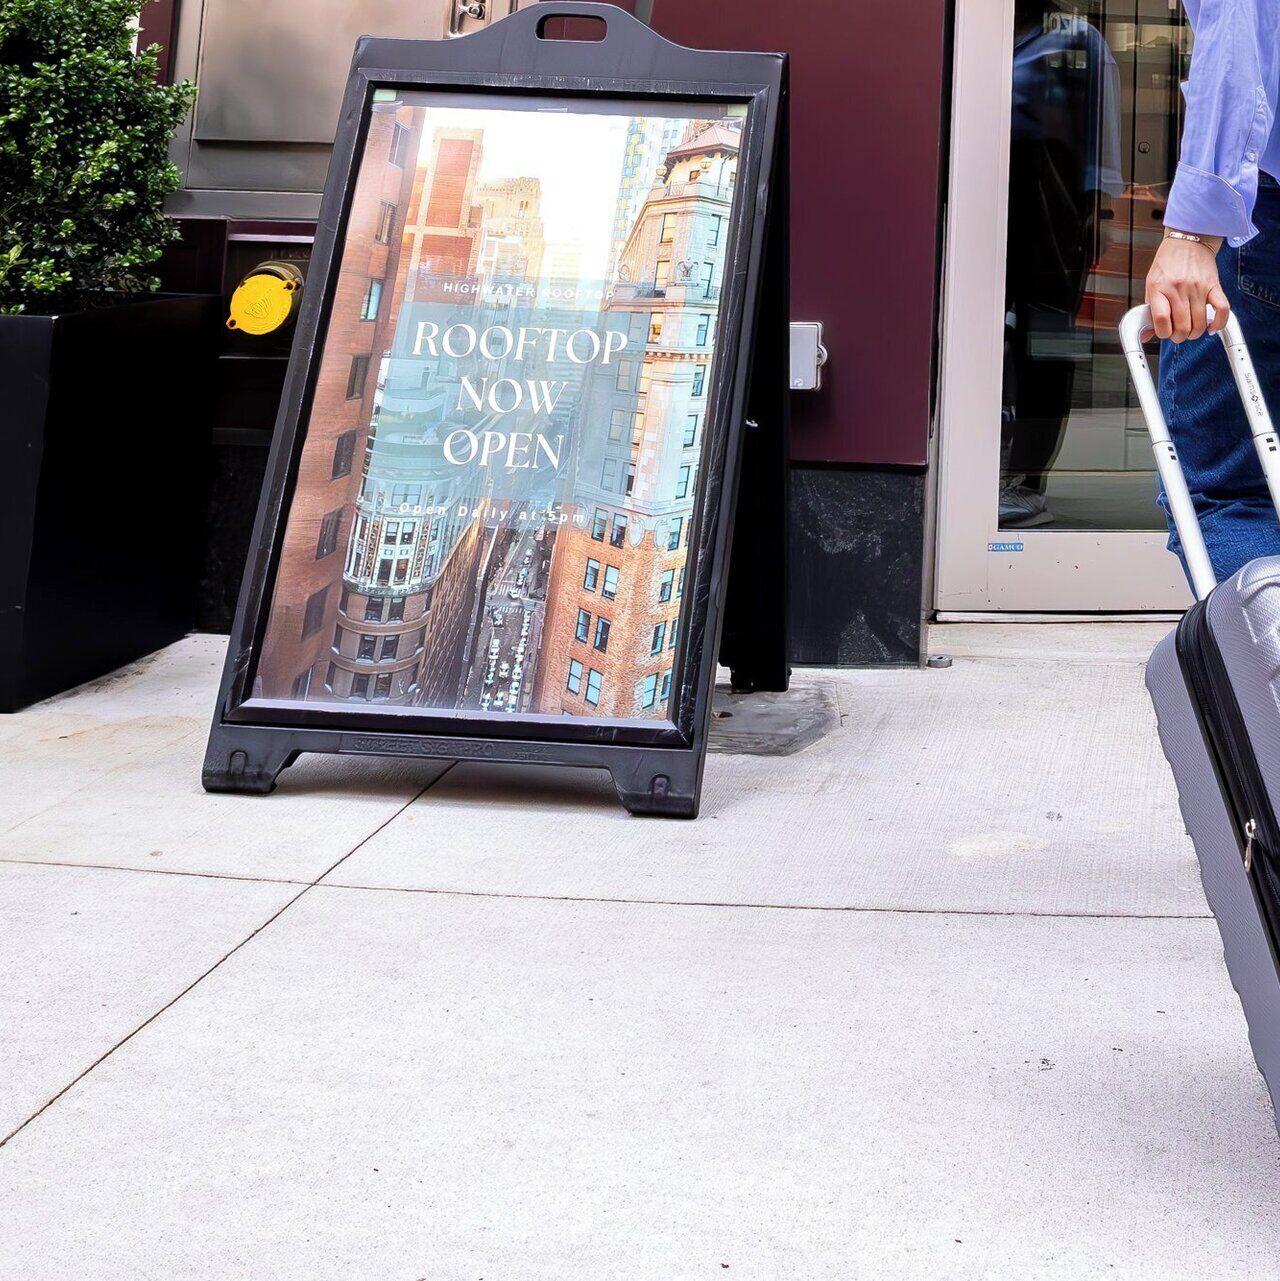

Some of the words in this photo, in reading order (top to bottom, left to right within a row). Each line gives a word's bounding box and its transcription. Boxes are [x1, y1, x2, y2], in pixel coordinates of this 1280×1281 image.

[443, 282, 536, 298] HIGHWATER
[412, 321, 629, 365] ROOFTOP
[456, 376, 569, 416] NOW
[443, 429, 565, 470] OPEN
[399, 502, 447, 516] Open
[457, 506, 509, 522] Daily
[519, 507, 537, 519] at
